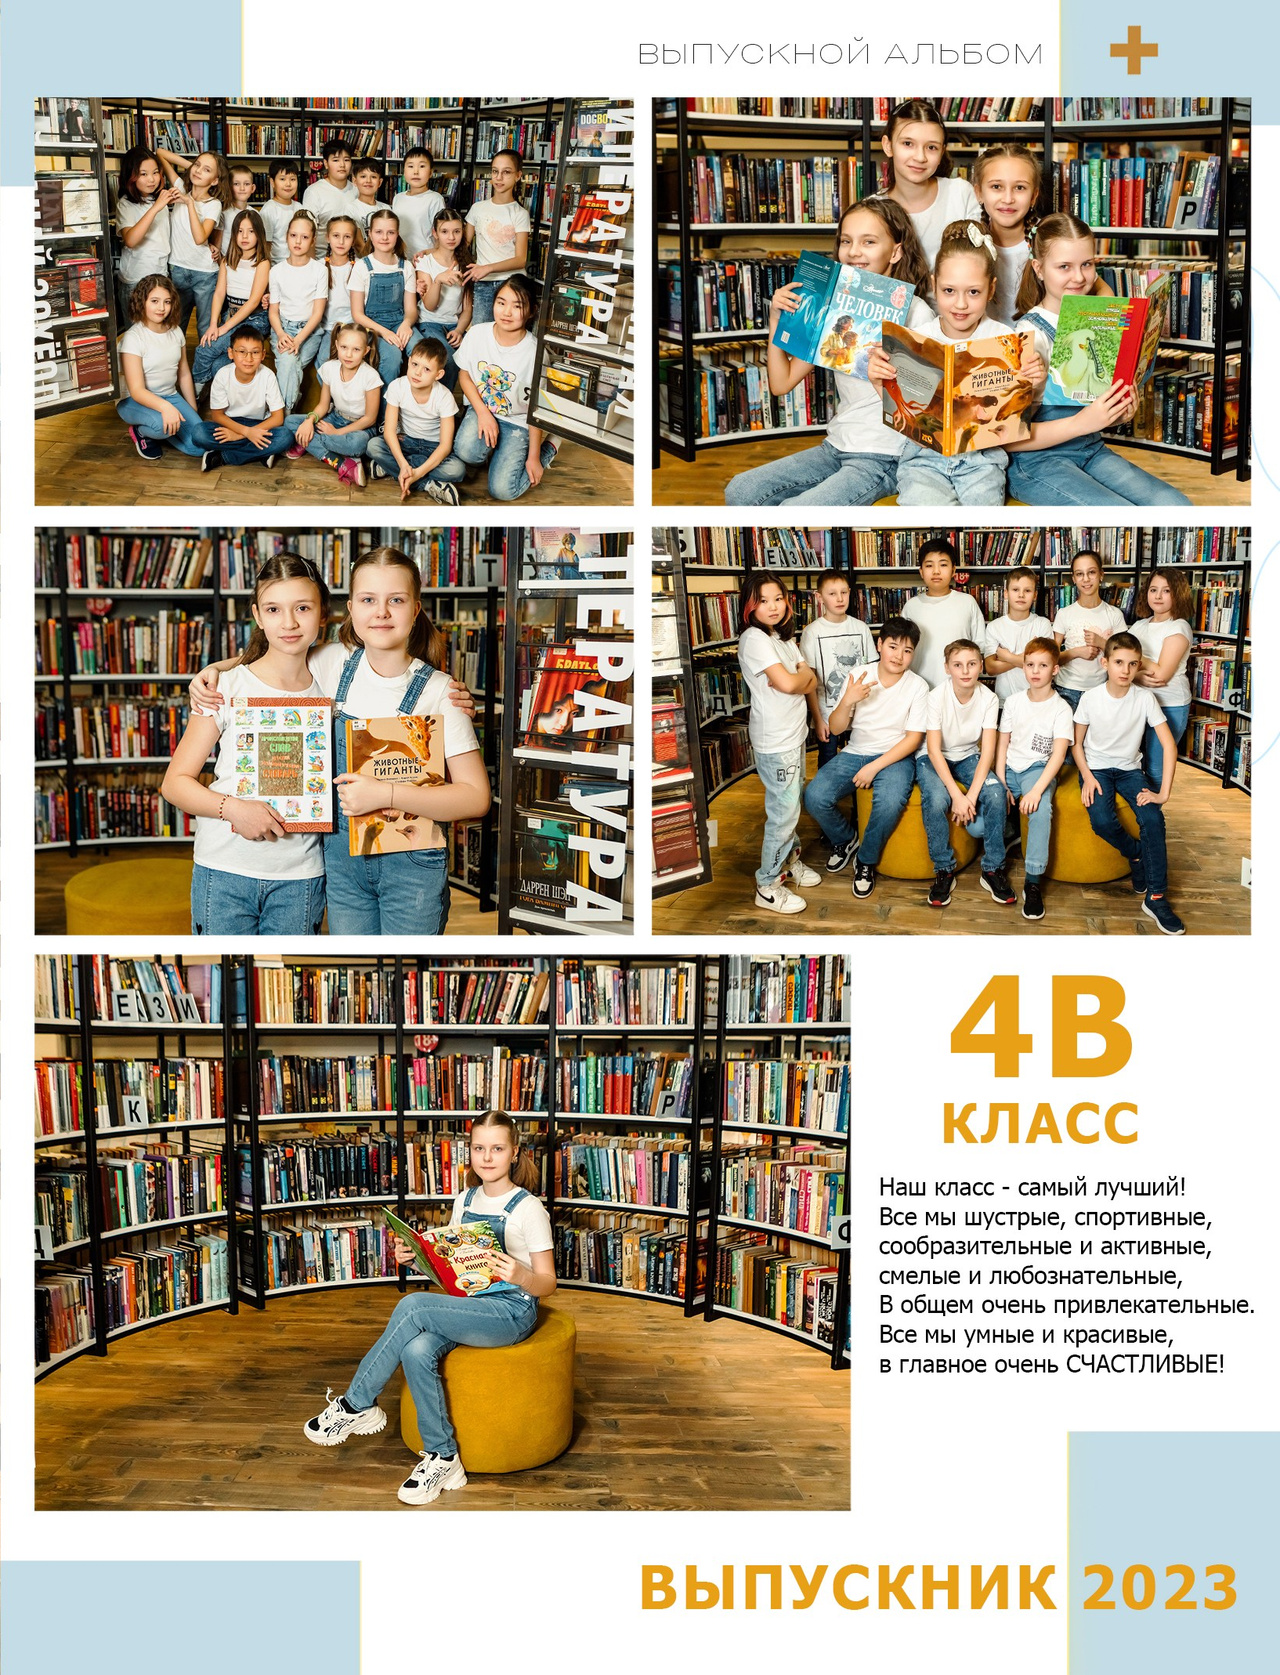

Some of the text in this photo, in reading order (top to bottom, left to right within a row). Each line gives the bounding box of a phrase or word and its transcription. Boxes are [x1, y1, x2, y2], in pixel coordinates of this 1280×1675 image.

[174, 138, 182, 151] З
[538, 143, 548, 159] Т
[1180, 200, 1198, 225] Р
[835, 291, 905, 326] ЧЕЛОВЕК
[972, 374, 1015, 389] ГИГАНТЫ
[767, 550, 777, 566] Е
[788, 551, 798, 566] З
[804, 552, 817, 566] И
[483, 558, 498, 582] Т
[565, 526, 635, 922] ТЕРАТУРА
[373, 755, 423, 769] ЖИВОТНЫЕ-
[373, 764, 423, 777] ГИГАНТЫ
[519, 878, 551, 898] ДАРРЕН
[116, 994, 131, 1017] Е
[152, 996, 165, 1018] З
[179, 998, 195, 1019] И
[128, 1100, 142, 1123] К
[660, 1091, 676, 1115] Р
